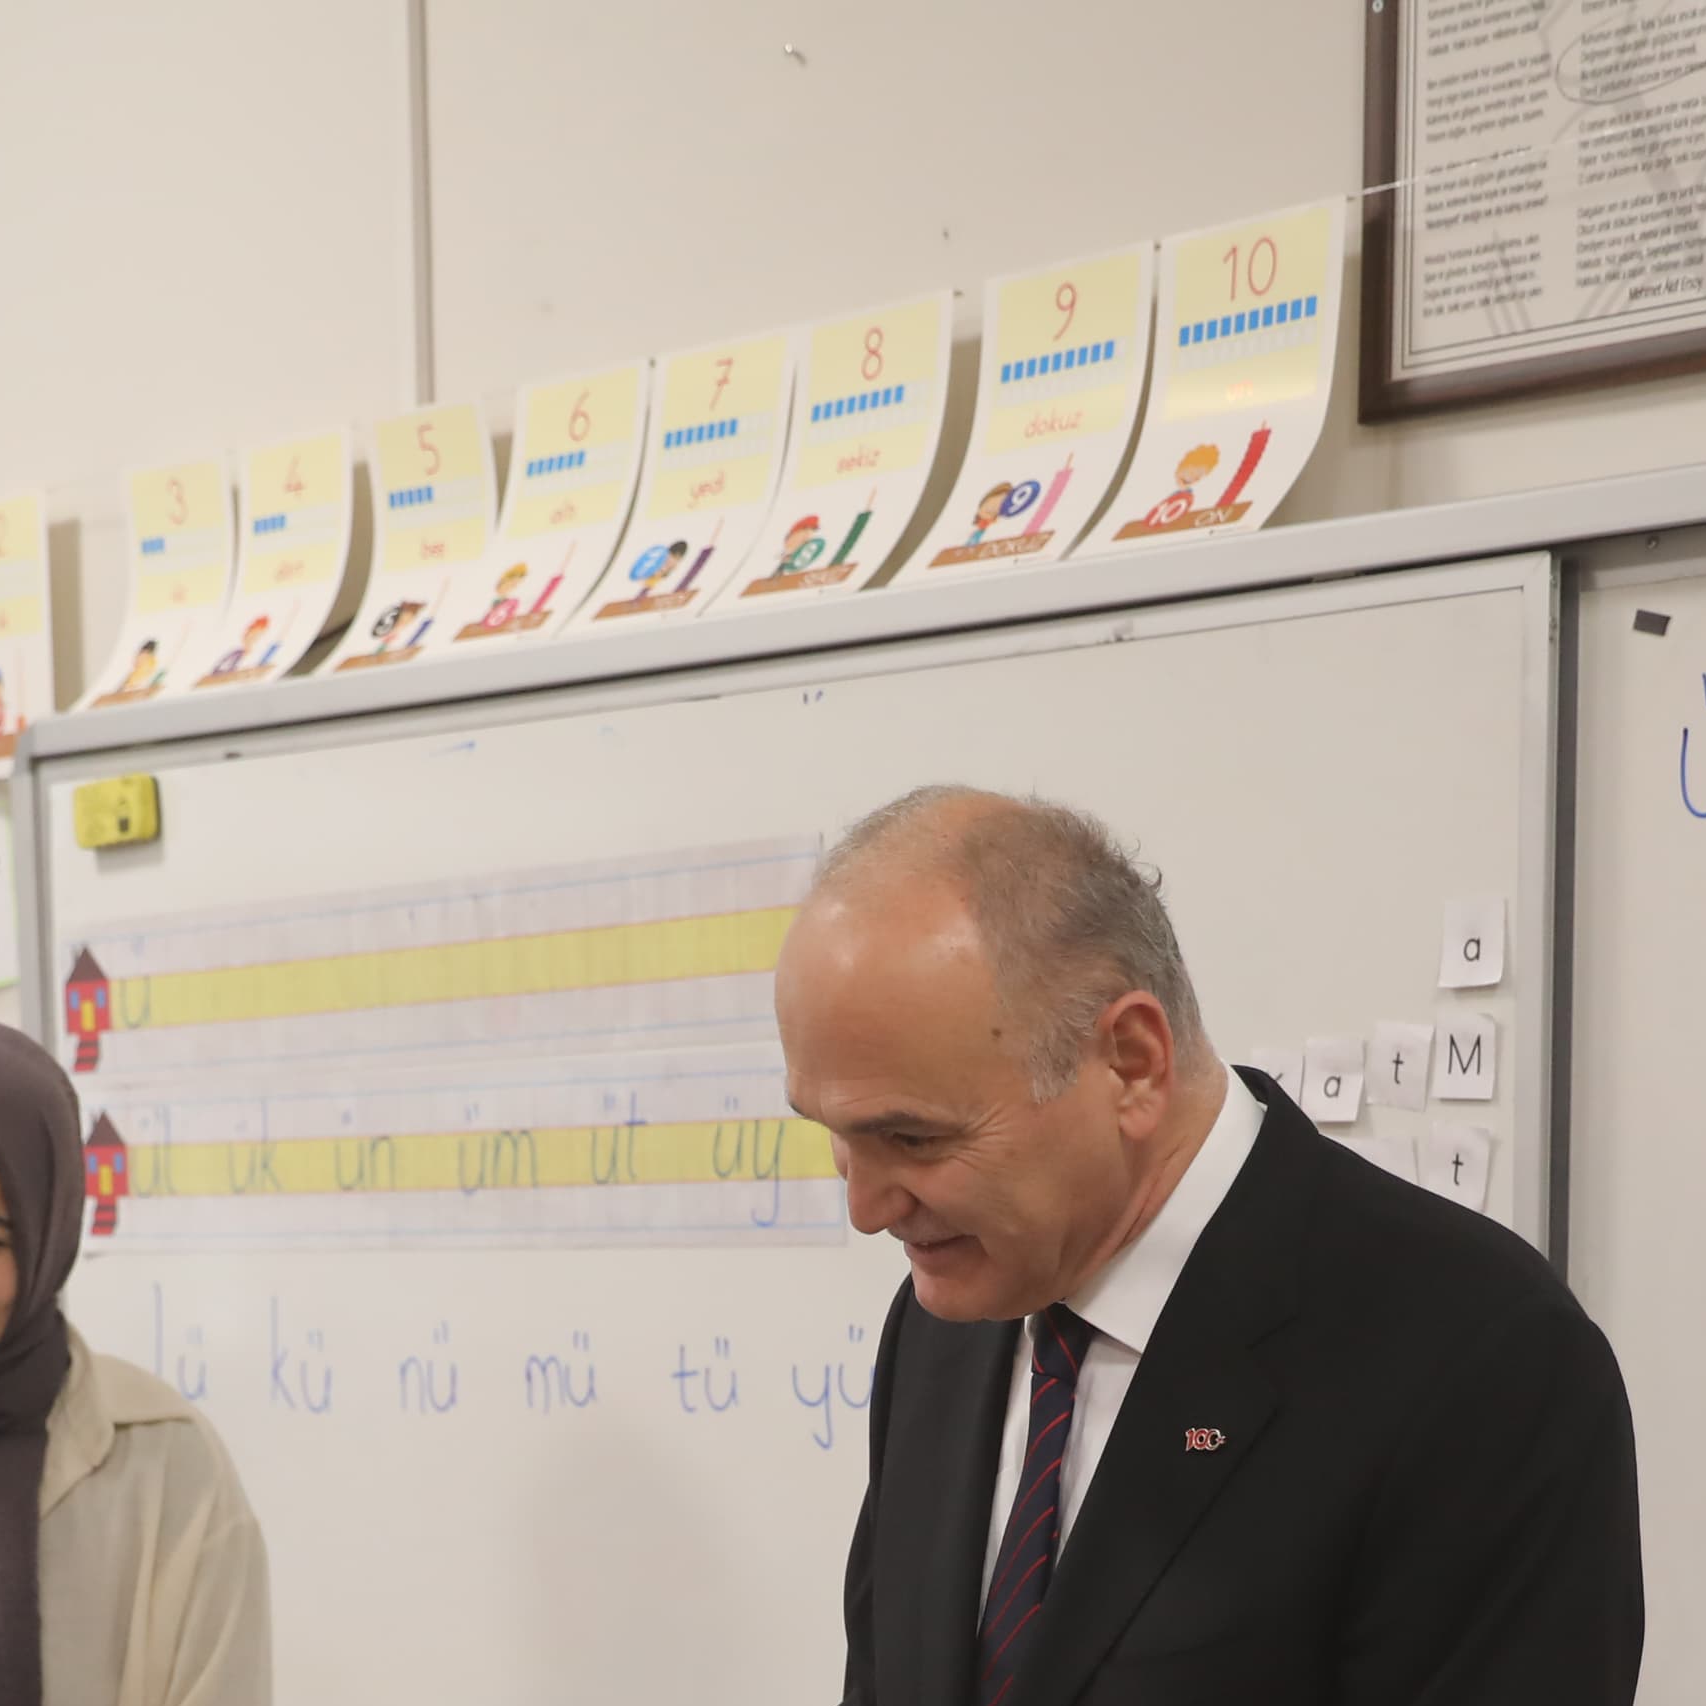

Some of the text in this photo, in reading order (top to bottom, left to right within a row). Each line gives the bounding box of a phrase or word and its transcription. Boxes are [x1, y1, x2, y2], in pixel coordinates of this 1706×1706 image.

[1223, 236, 1278, 302] 10
[1052, 281, 1078, 342] 9
[860, 326, 885, 382] 8
[709, 356, 735, 411] 7
[568, 388, 591, 443] 6
[1023, 405, 1085, 440] dokuz
[416, 422, 441, 478] 5
[1148, 498, 1188, 528] 10
[1462, 936, 1482, 963] a
[1322, 1033, 1483, 1099] a t M
[713, 1095, 786, 1228] üy
[1452, 1152, 1465, 1187] t
[269, 1296, 334, 1414] kü
[397, 1319, 459, 1414] nü
[525, 1331, 597, 1416] mü
[671, 1336, 740, 1414] tü
[792, 1324, 876, 1451] yü
